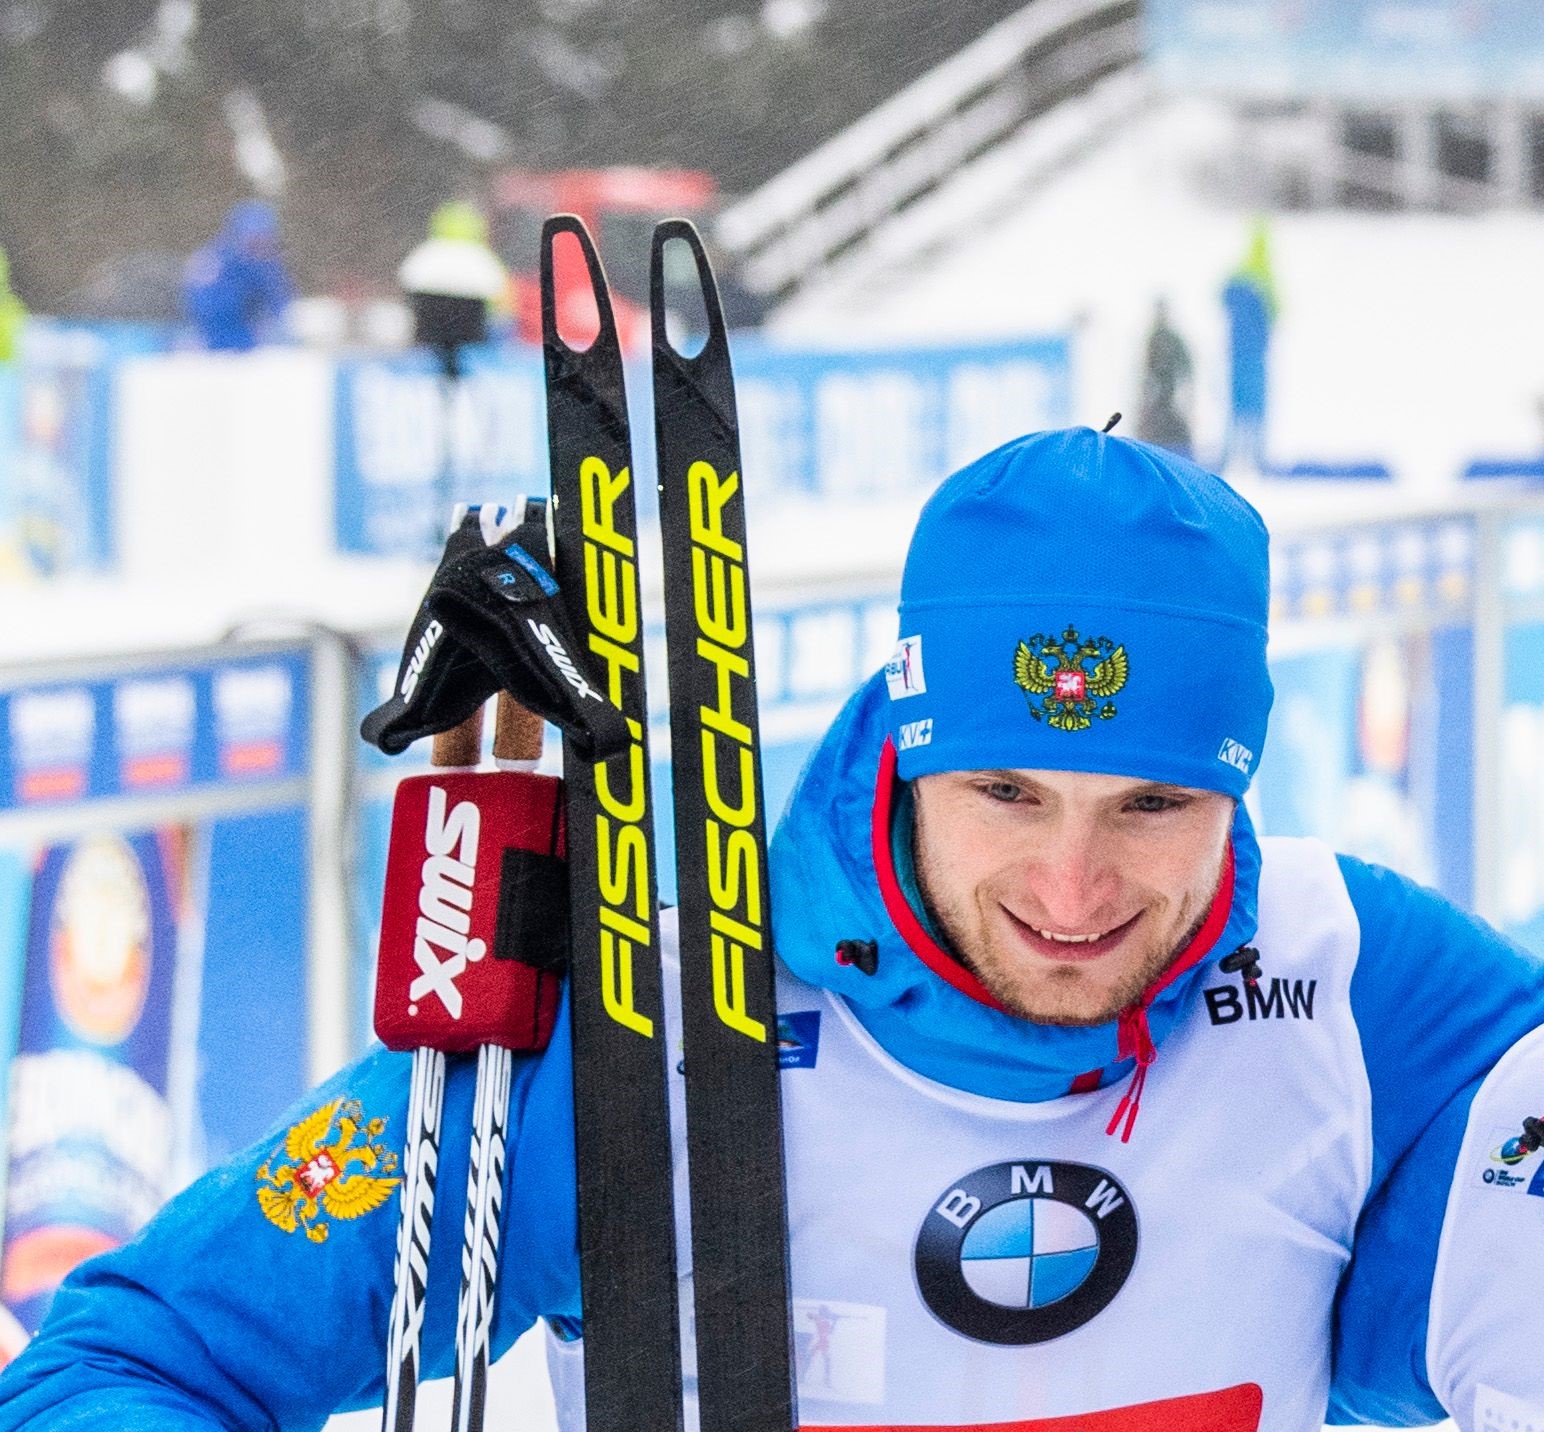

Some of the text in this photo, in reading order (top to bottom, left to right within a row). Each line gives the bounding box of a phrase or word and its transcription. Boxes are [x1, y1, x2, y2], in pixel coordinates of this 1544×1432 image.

[688, 460, 766, 1043] FISCHER
[1204, 978, 1317, 1026] BMW
[937, 1166, 1125, 1230] BMW
